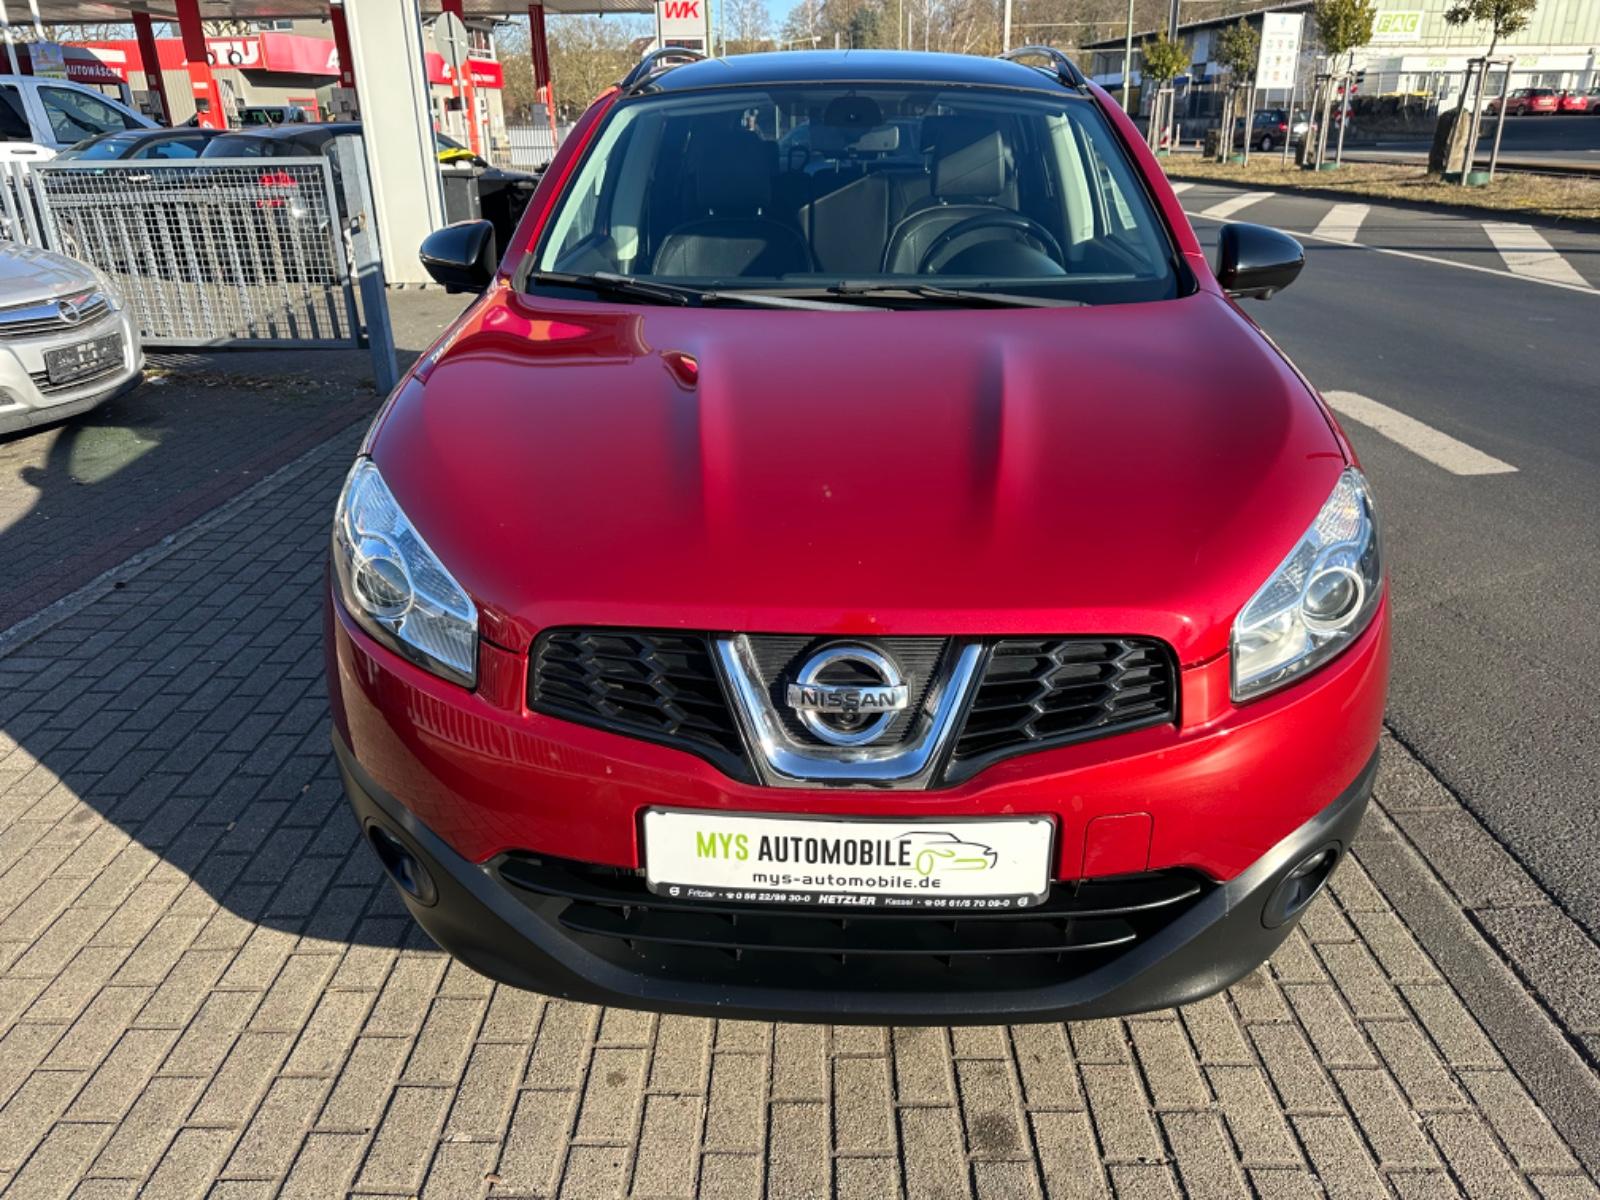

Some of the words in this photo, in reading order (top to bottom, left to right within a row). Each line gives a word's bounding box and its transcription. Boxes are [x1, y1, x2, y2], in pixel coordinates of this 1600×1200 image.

[665, 1, 699, 18] WK
[801, 690, 896, 708] NISSAN
[696, 831, 749, 861] MYS
[757, 835, 912, 866] AUTOMOBILE
[752, 872, 941, 889] mys-automobile.de
[818, 894, 876, 905] HETZLER
